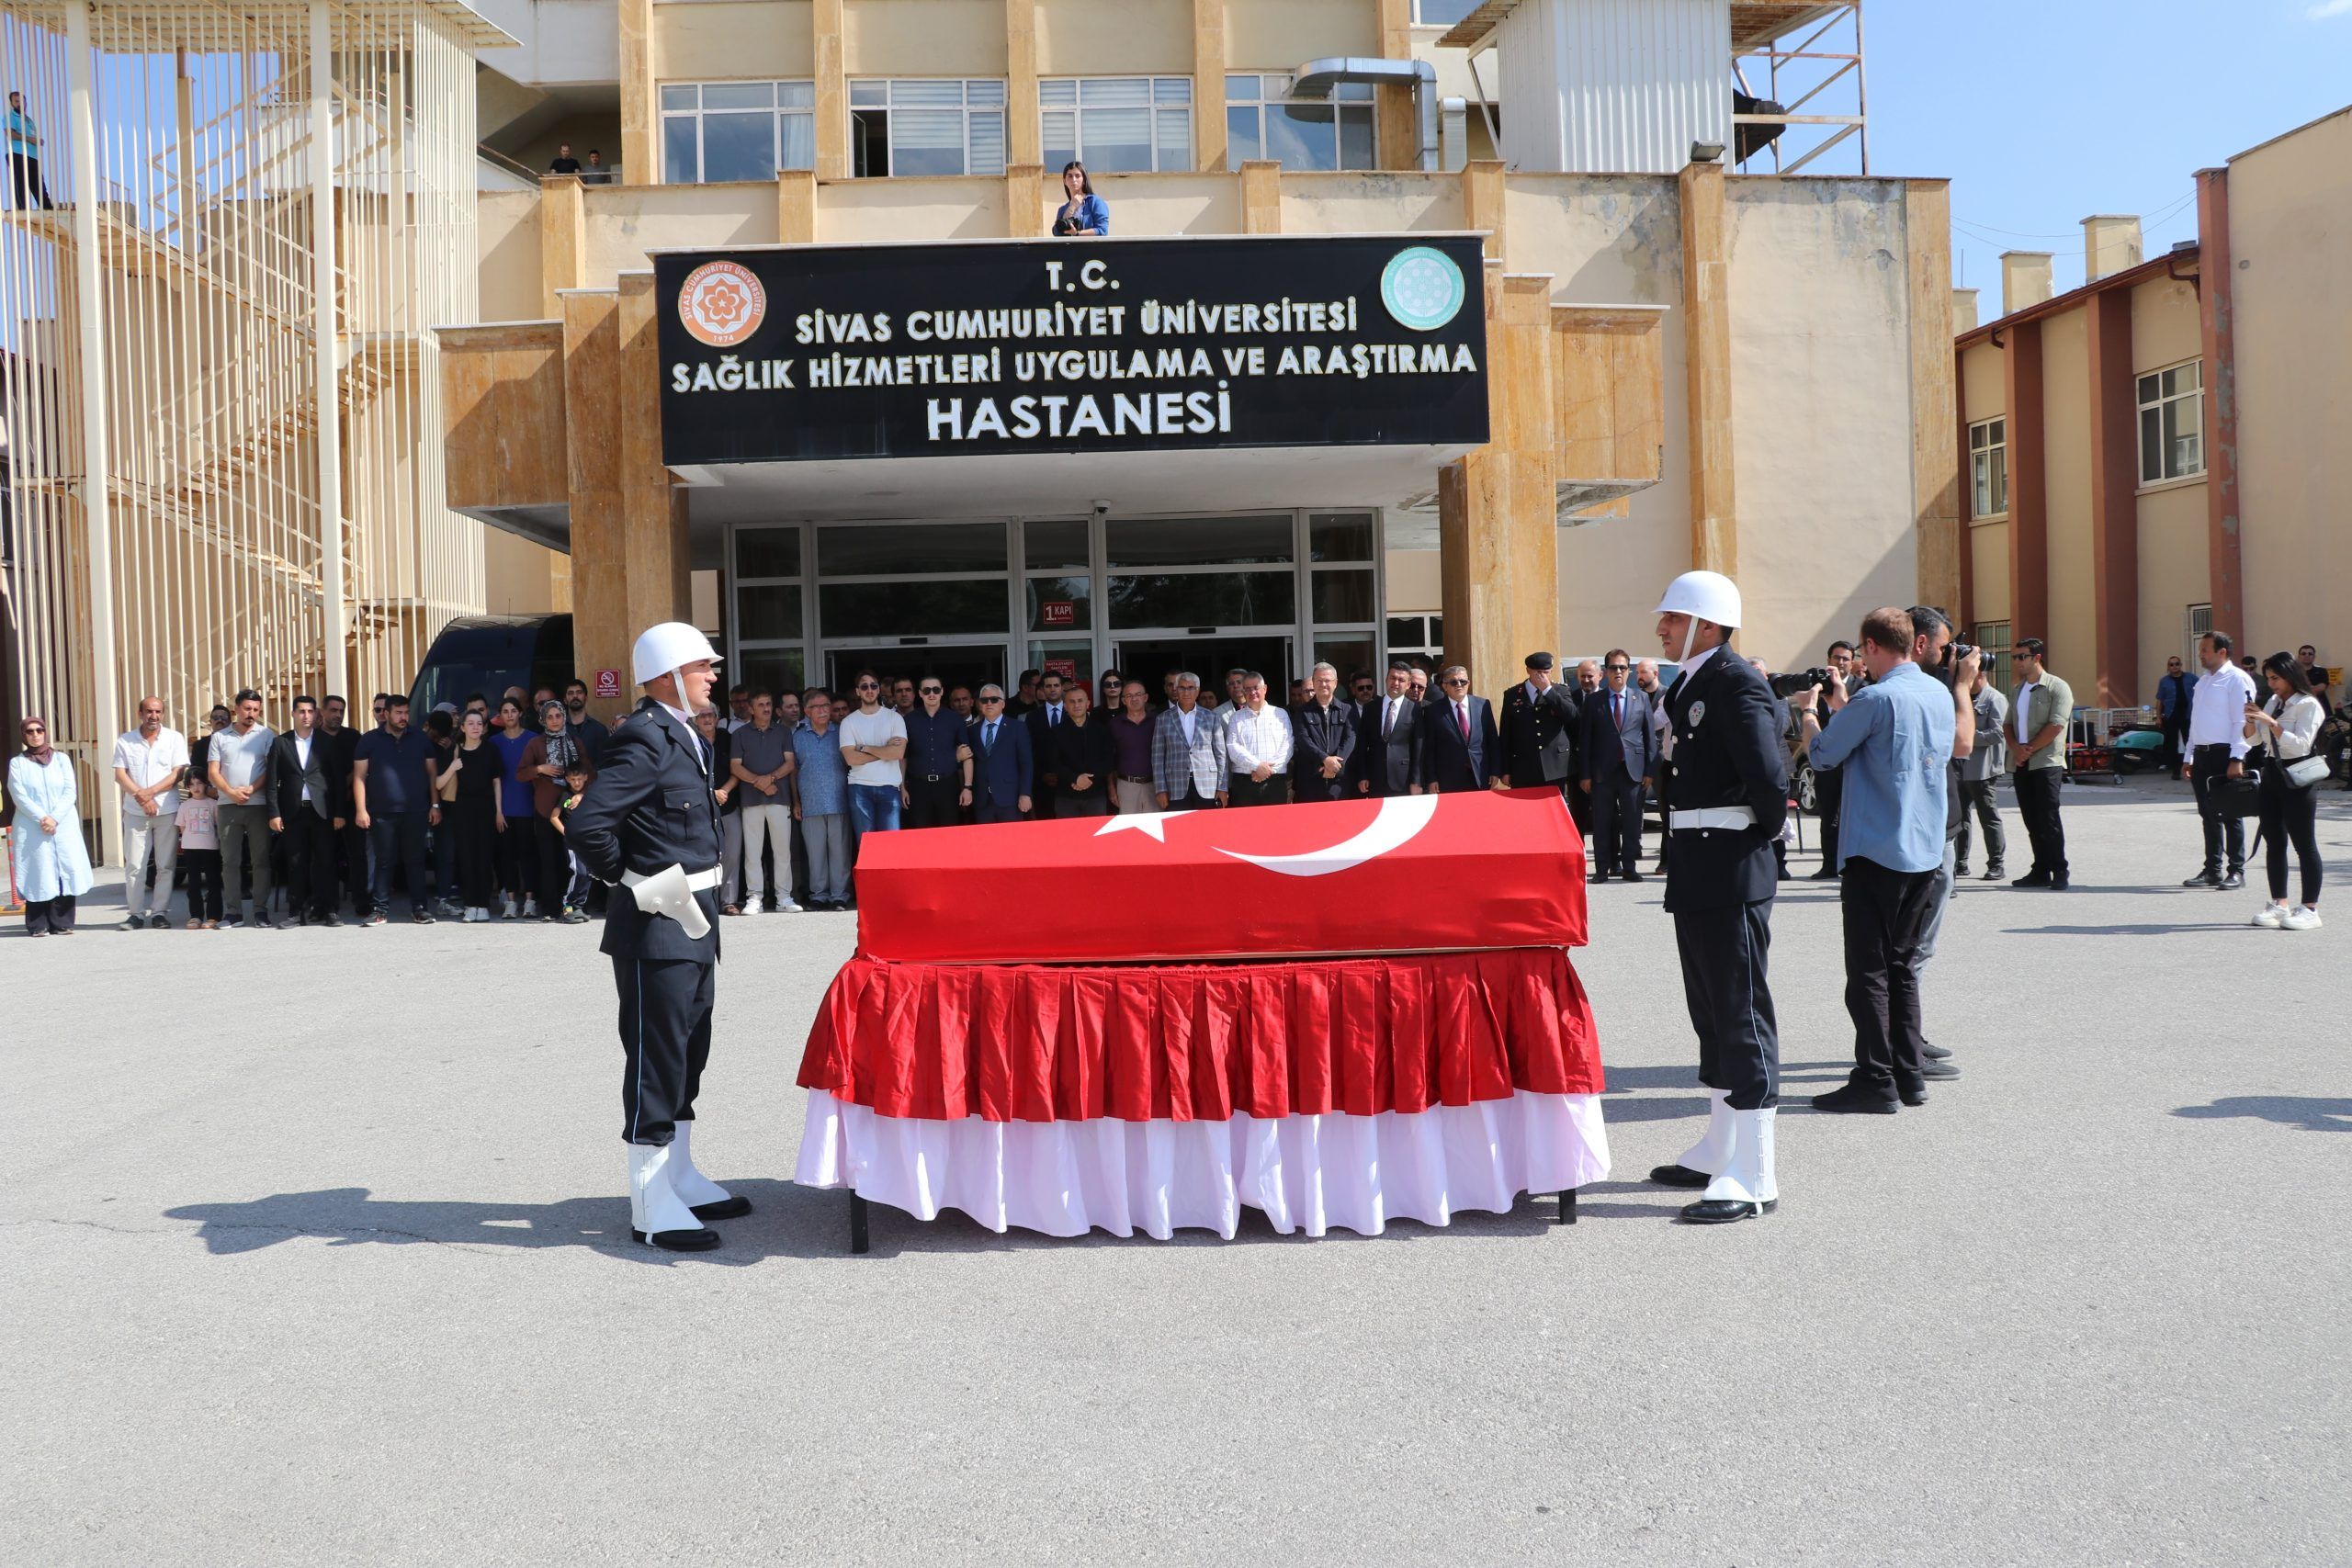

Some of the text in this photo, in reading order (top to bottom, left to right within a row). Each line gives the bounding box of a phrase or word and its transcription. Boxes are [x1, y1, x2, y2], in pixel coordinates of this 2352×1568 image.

[686, 264, 733, 291] CUMHURİYET
[735, 266, 763, 315] ÜNİVERSİTESİ
[1046, 259, 1120, 292] T.C.
[795, 297, 1357, 344] SİVAS CUMHURİYET ÜNİVERSİTESİ
[672, 344, 1477, 393] SAĞLIK HİZMETLERİ UYGULAMA VE ARAŞTIRMA
[926, 380, 1232, 441] HASTANESİ
[1046, 605, 1071, 621] 1. KAPI
